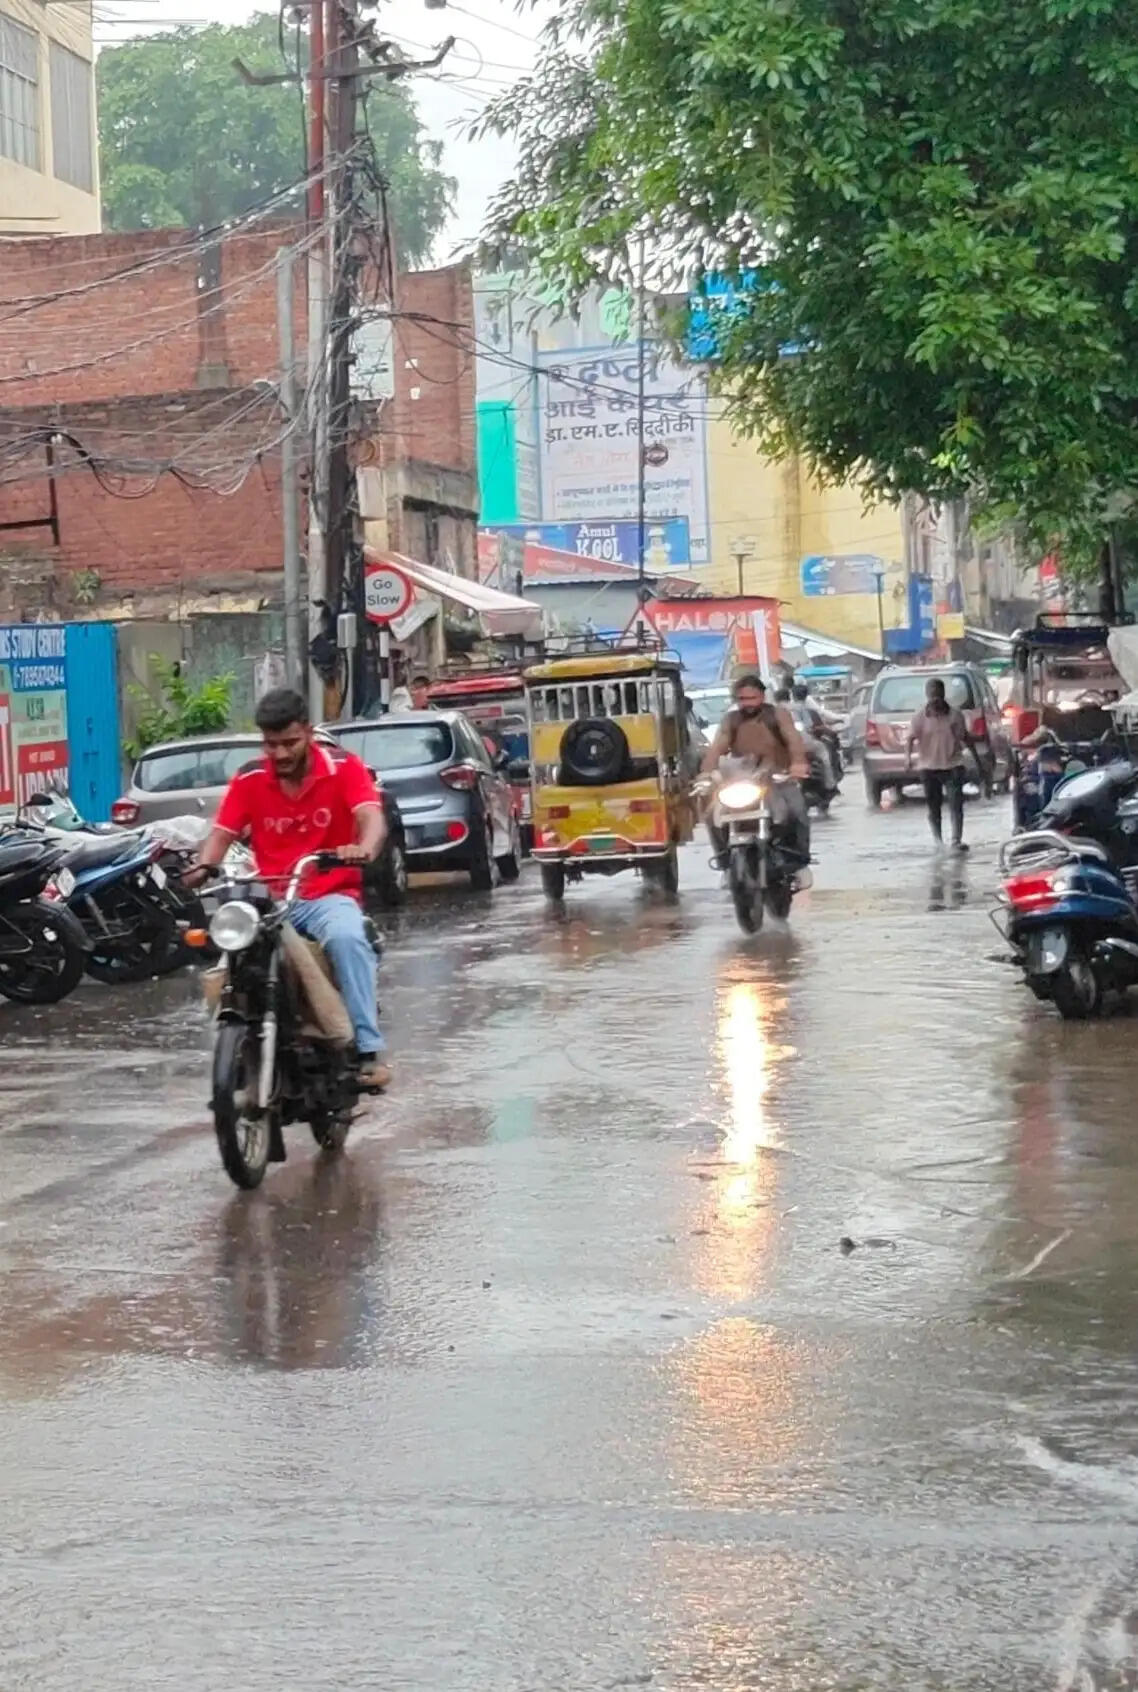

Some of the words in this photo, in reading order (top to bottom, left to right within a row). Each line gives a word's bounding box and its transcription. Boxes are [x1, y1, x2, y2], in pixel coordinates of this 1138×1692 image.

[577, 524, 617, 538] Amul
[576, 537, 623, 561] KOOL
[372, 579, 393, 590] Go
[367, 594, 400, 606] Slow
